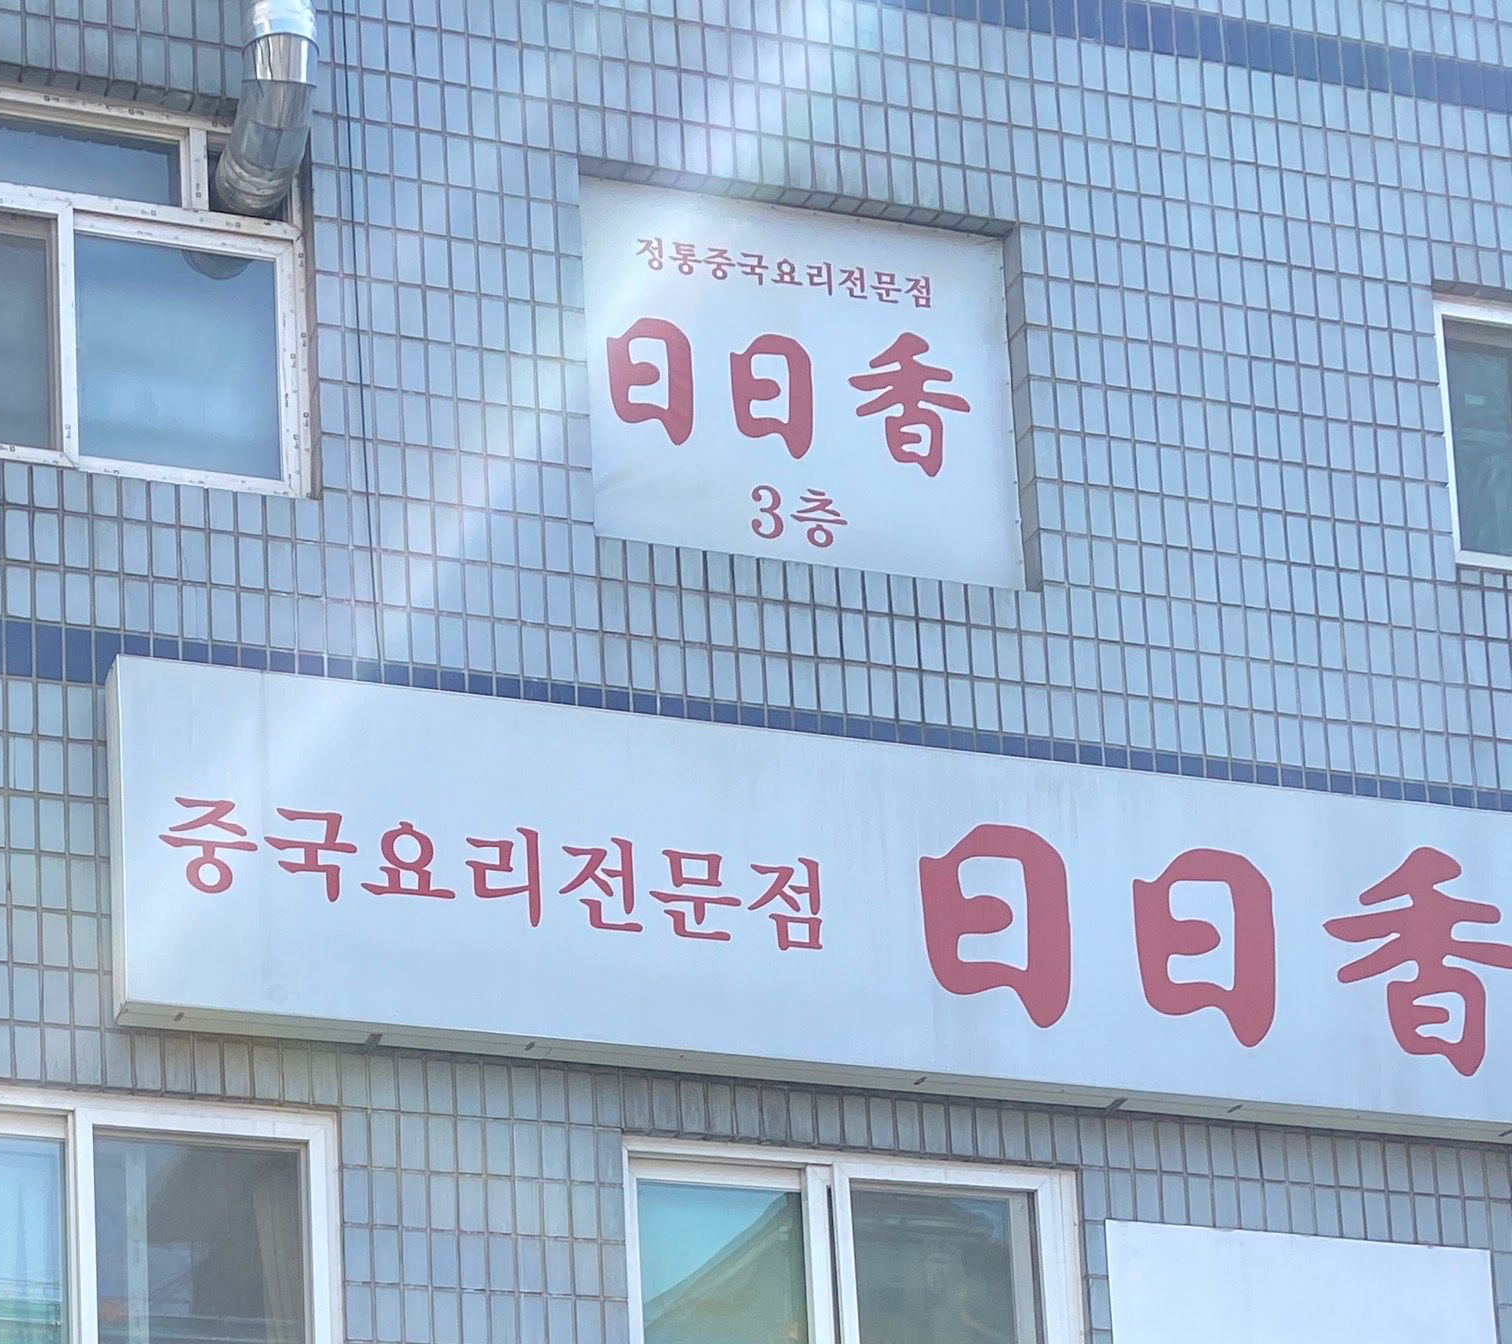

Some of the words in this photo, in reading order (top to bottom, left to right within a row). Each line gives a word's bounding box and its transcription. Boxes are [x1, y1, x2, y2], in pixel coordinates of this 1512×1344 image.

[636, 237, 934, 309] 정통중국요리전문점
[607, 317, 971, 478] 日日香
[751, 485, 848, 549] 3층
[159, 795, 825, 952] 중국요리전문점
[919, 822, 1512, 1077] 日日香
